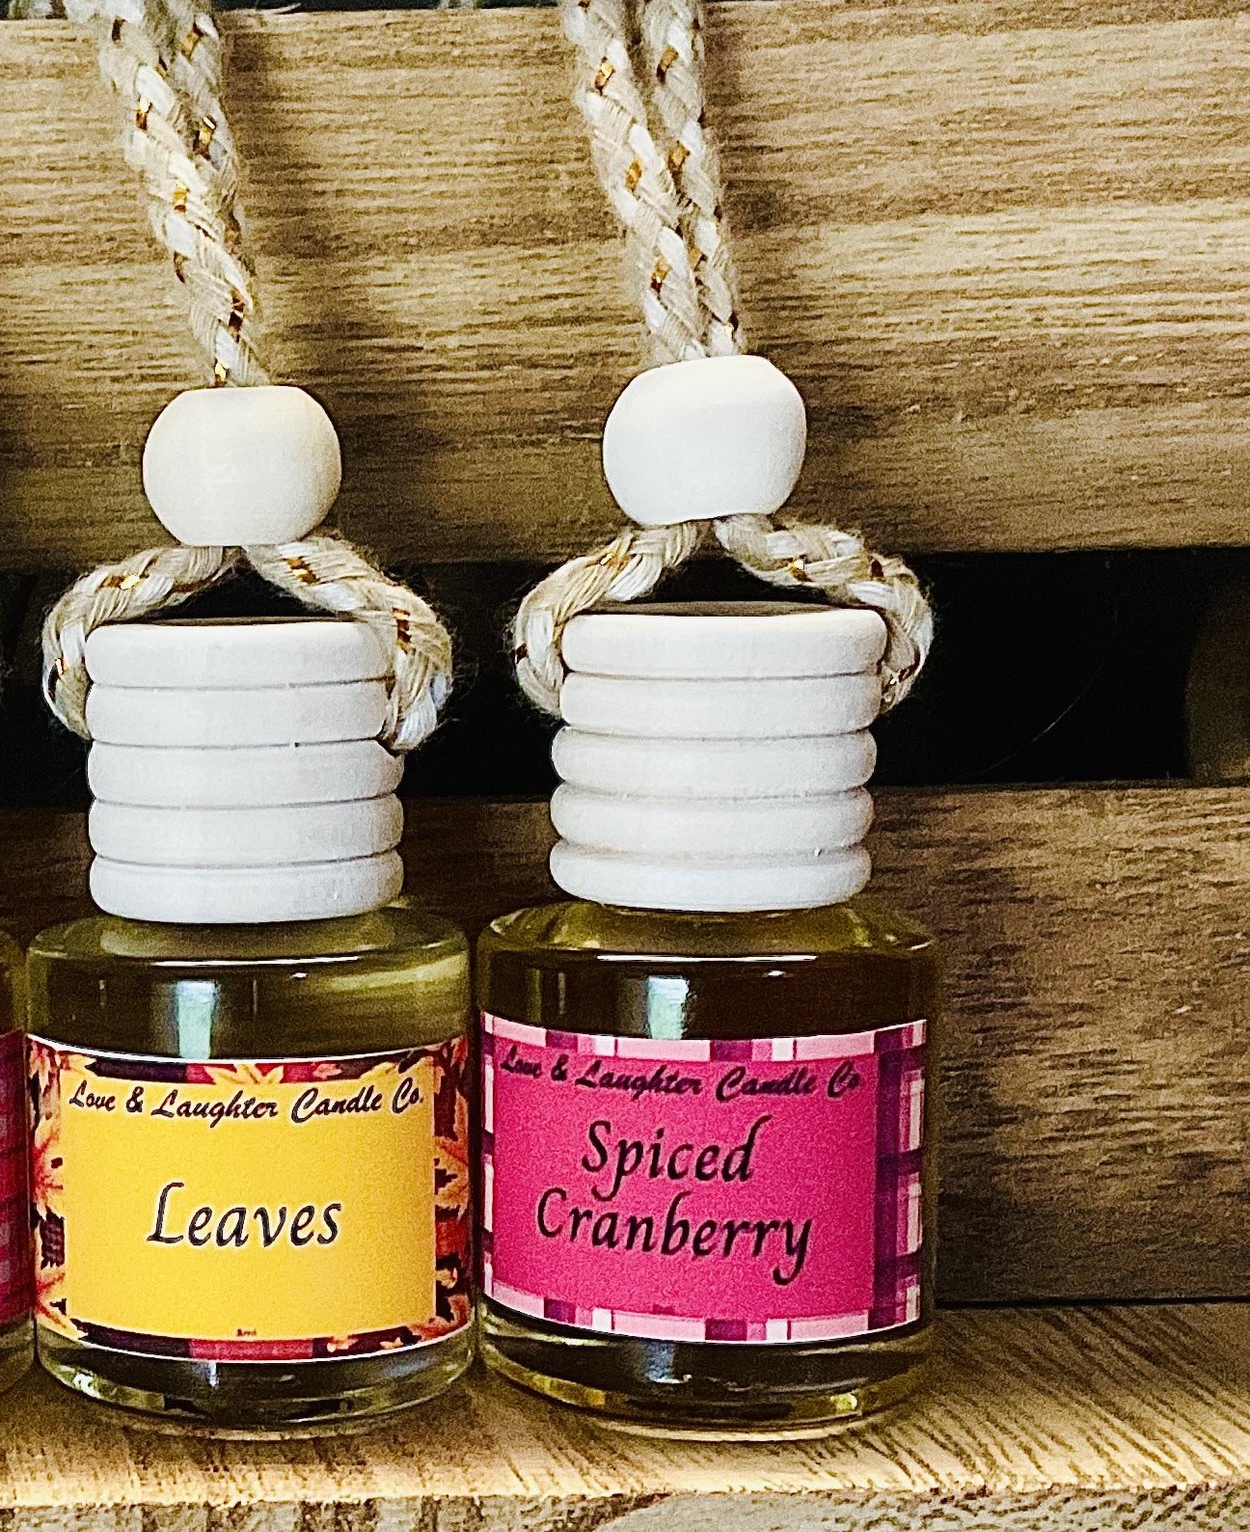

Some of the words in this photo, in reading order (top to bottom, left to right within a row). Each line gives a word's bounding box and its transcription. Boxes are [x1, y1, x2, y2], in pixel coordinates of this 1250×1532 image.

[69, 1080, 117, 1111] Love
[126, 1086, 143, 1113] &
[152, 1089, 277, 1128] Laughter
[291, 1085, 382, 1124] Candle
[392, 1077, 424, 1113] Co.
[499, 1046, 542, 1079] Love
[551, 1054, 569, 1081] &
[575, 1060, 701, 1100] Laughter
[716, 1066, 816, 1101] Candle
[581, 1115, 773, 1200] Spiced
[147, 1182, 342, 1248] Leaves
[537, 1190, 812, 1286] Cranberry
